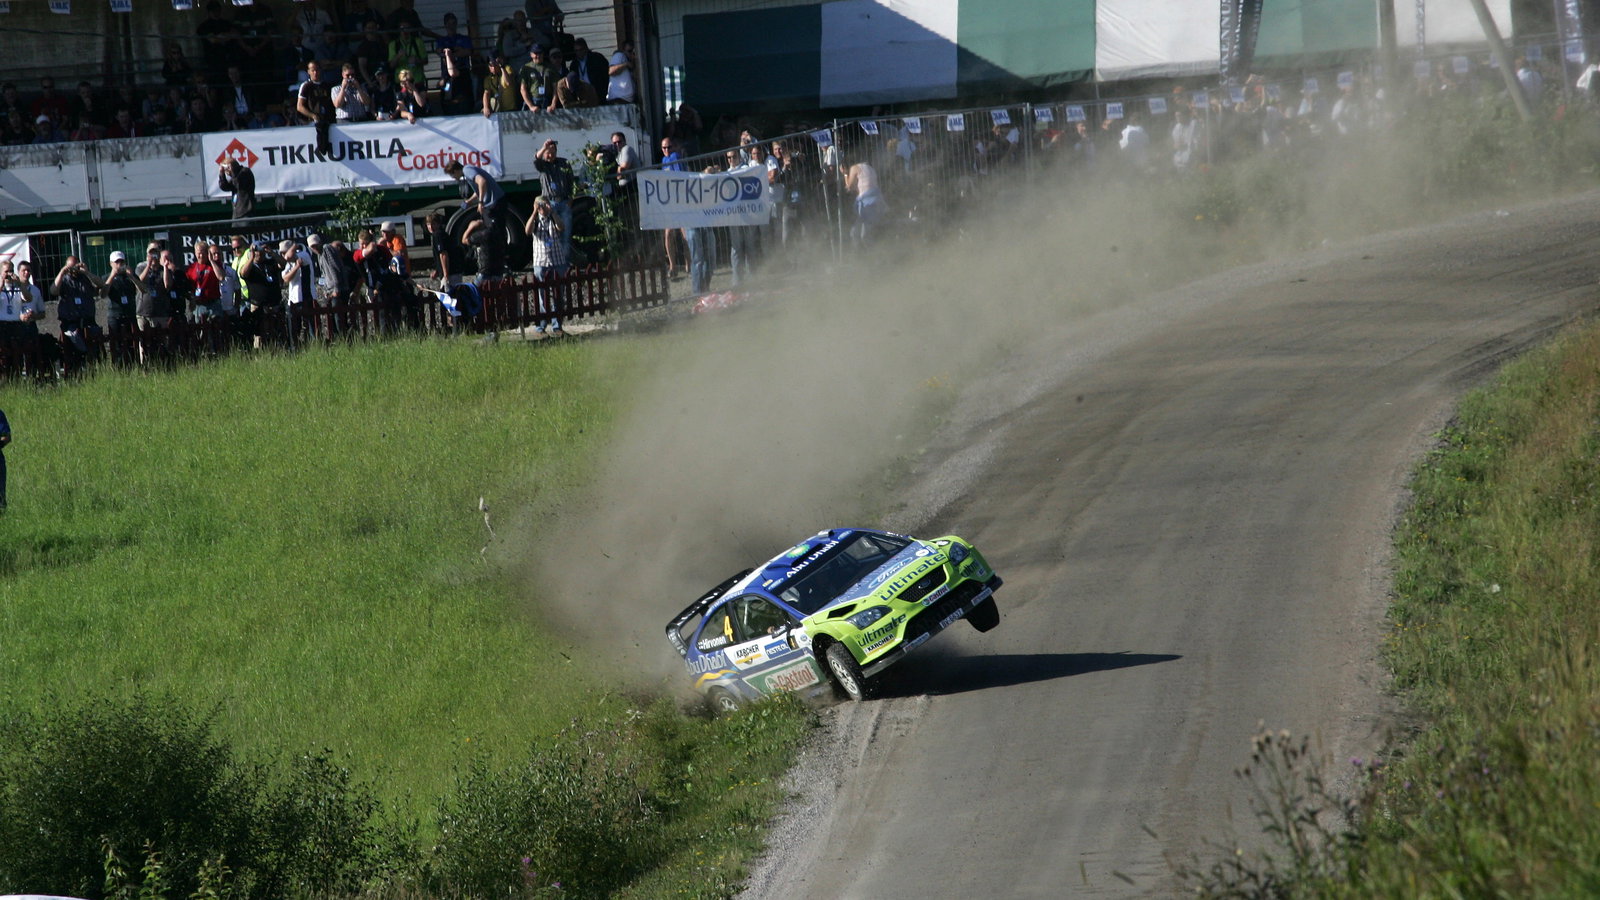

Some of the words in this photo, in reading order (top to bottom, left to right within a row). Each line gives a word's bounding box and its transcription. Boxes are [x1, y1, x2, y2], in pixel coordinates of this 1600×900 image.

[262, 138, 407, 166] TIKKURILA
[398, 147, 492, 171] Coatings
[644, 176, 739, 205] PUTKI-10
[743, 183, 760, 193] OY
[786, 561, 809, 578] Abu
[808, 540, 839, 560] Dhabi
[880, 553, 947, 601] ultimate
[702, 635, 727, 650] Hirvonen
[724, 616, 734, 642] 4
[857, 614, 907, 647] ultimate
[698, 650, 727, 673] Dhabi
[776, 666, 816, 691] Castrol
